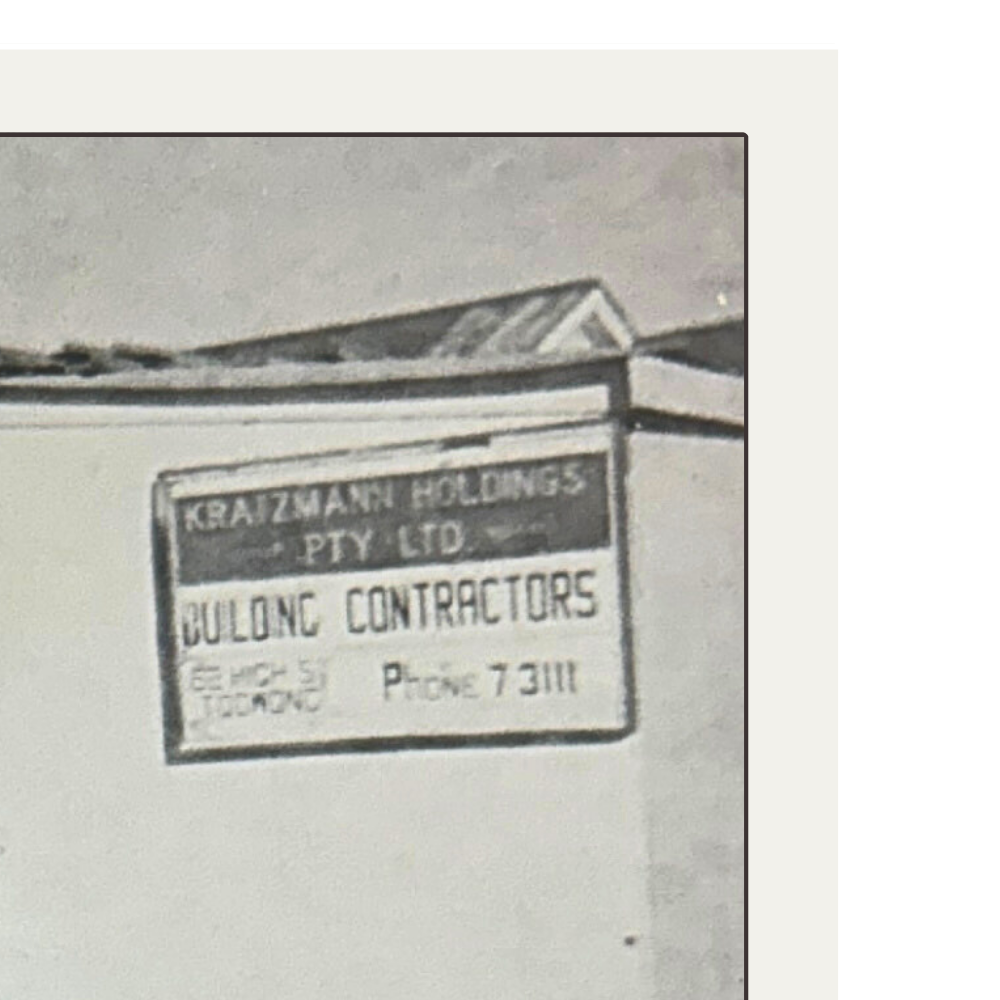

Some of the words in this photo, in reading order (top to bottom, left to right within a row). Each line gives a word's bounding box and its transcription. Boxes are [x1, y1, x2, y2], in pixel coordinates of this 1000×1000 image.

[303, 529, 373, 564] PTY
[346, 570, 597, 634] CONTRACTORS
[489, 661, 508, 697] 7
[518, 660, 577, 696] 3111
